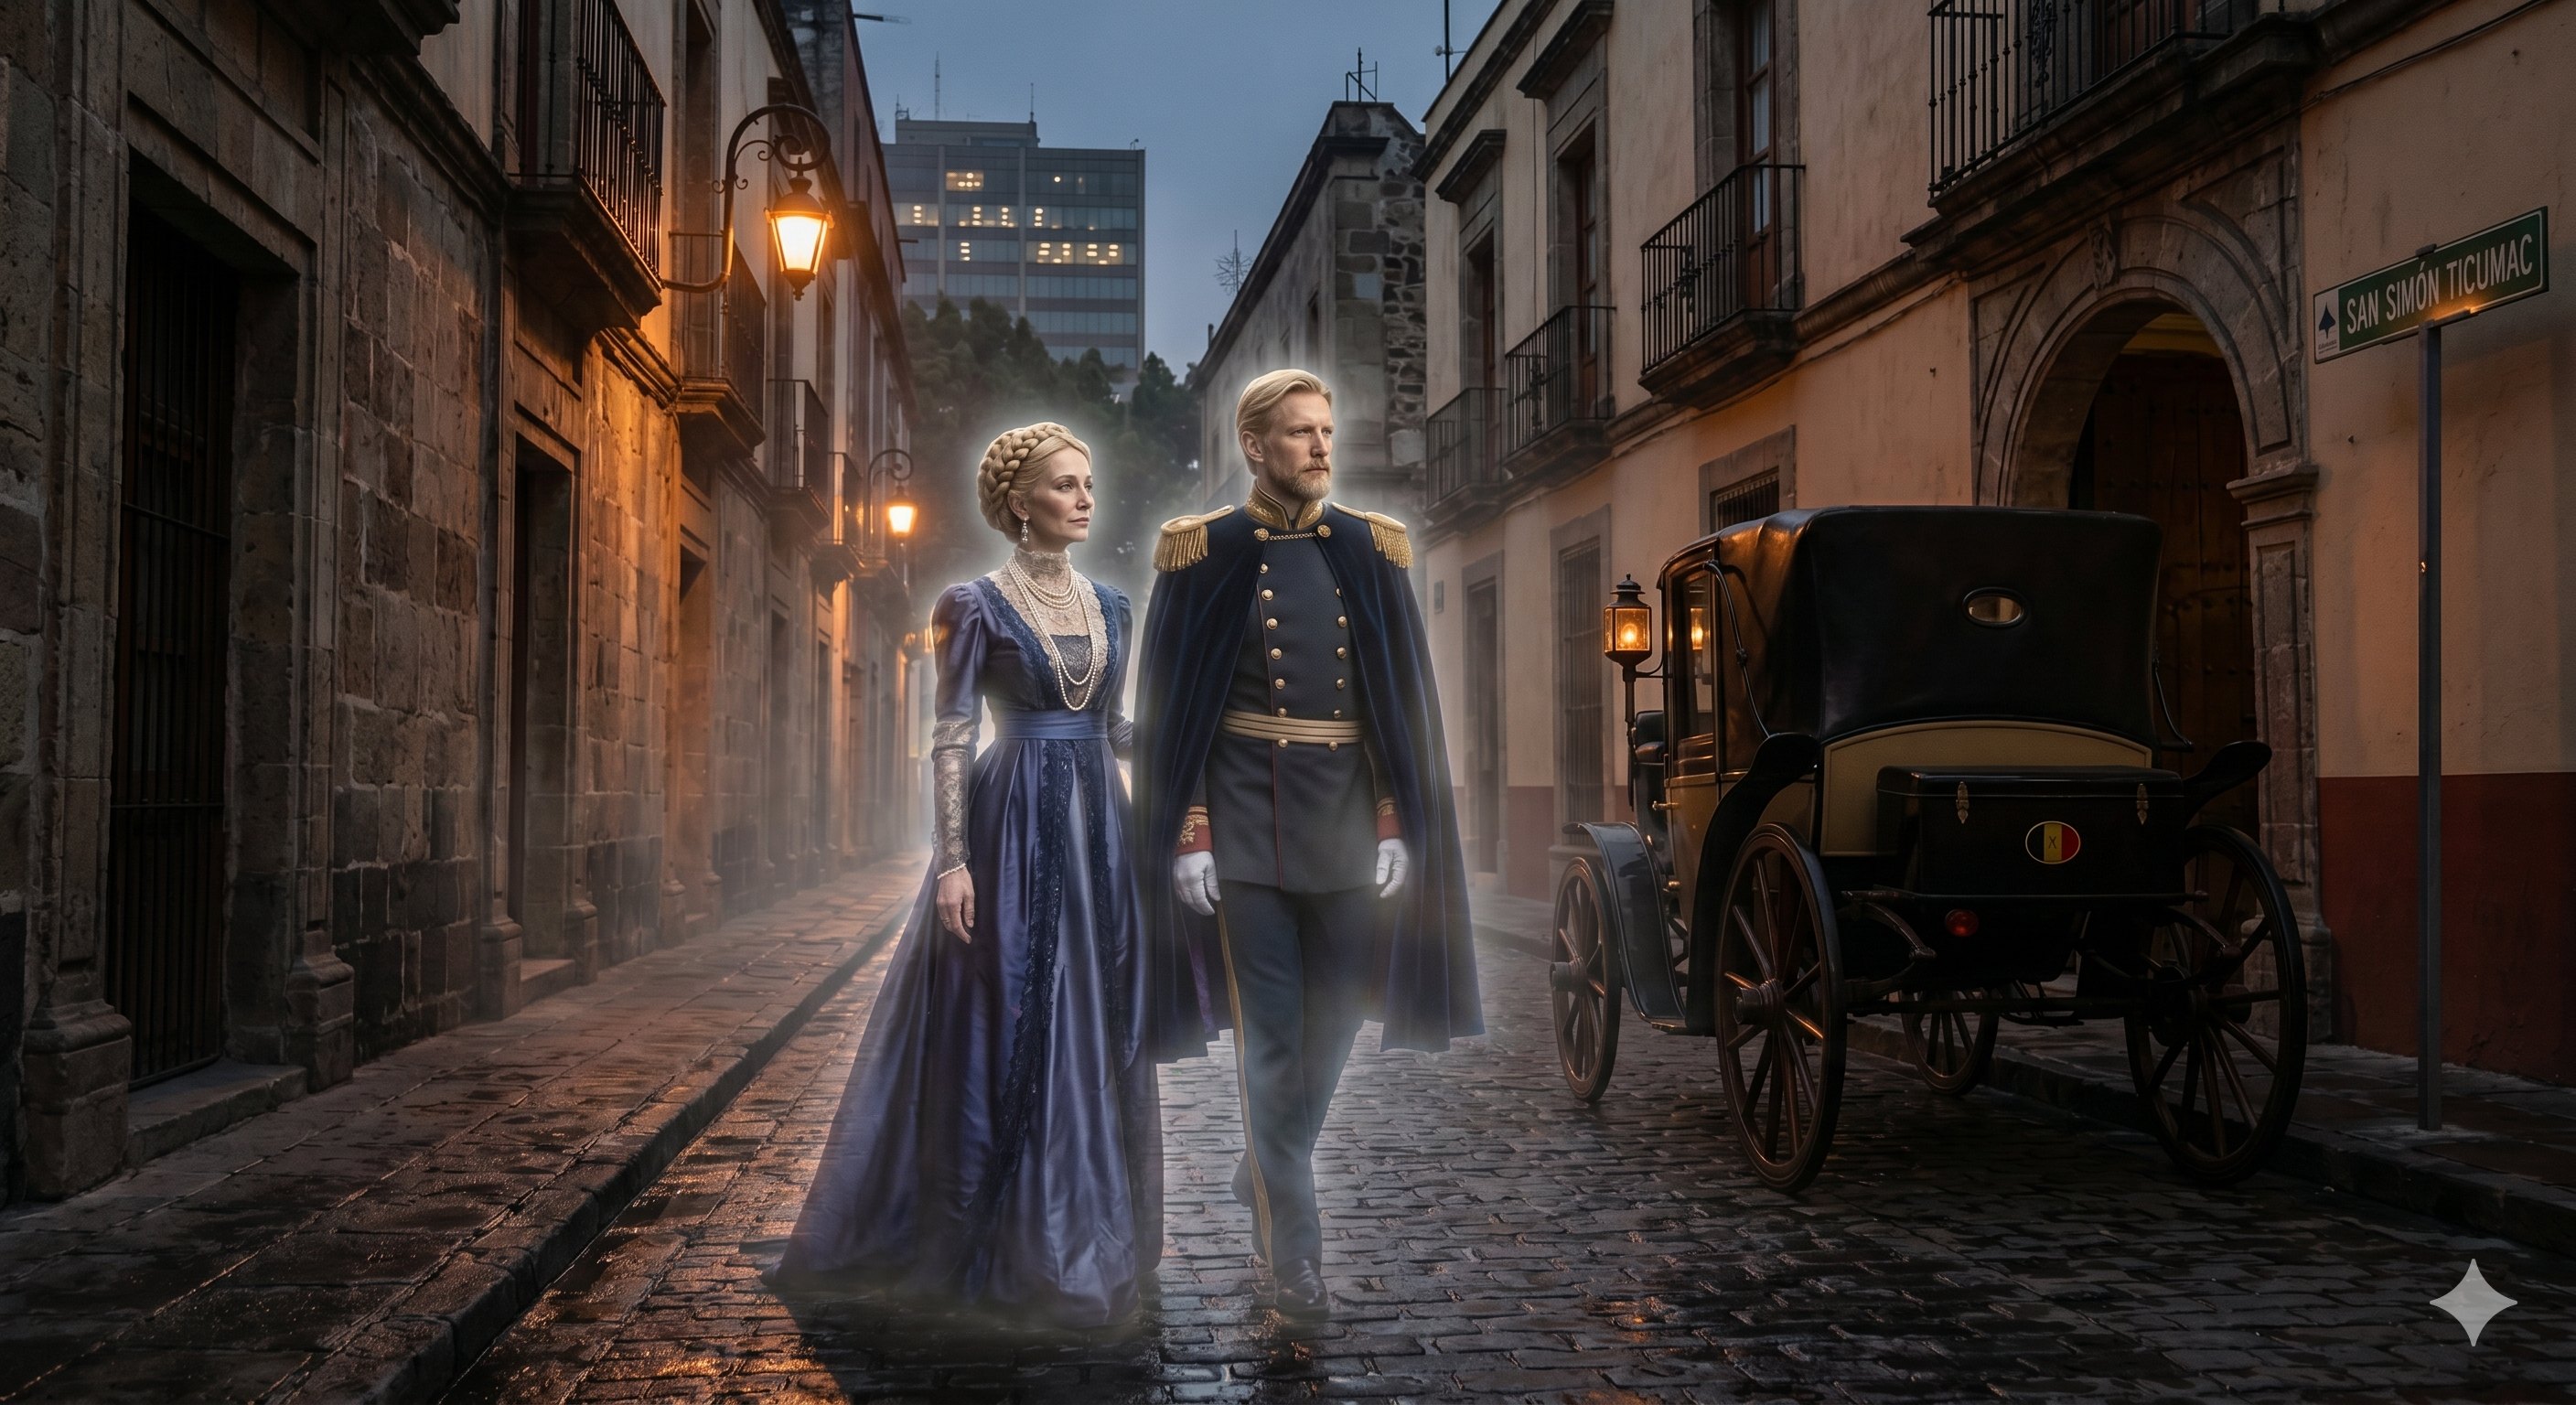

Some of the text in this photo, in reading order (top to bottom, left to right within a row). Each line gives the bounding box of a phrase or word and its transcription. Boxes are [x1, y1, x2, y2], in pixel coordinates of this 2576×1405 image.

[2346, 233, 2533, 335] SAN SIMÓN TICUMAC
